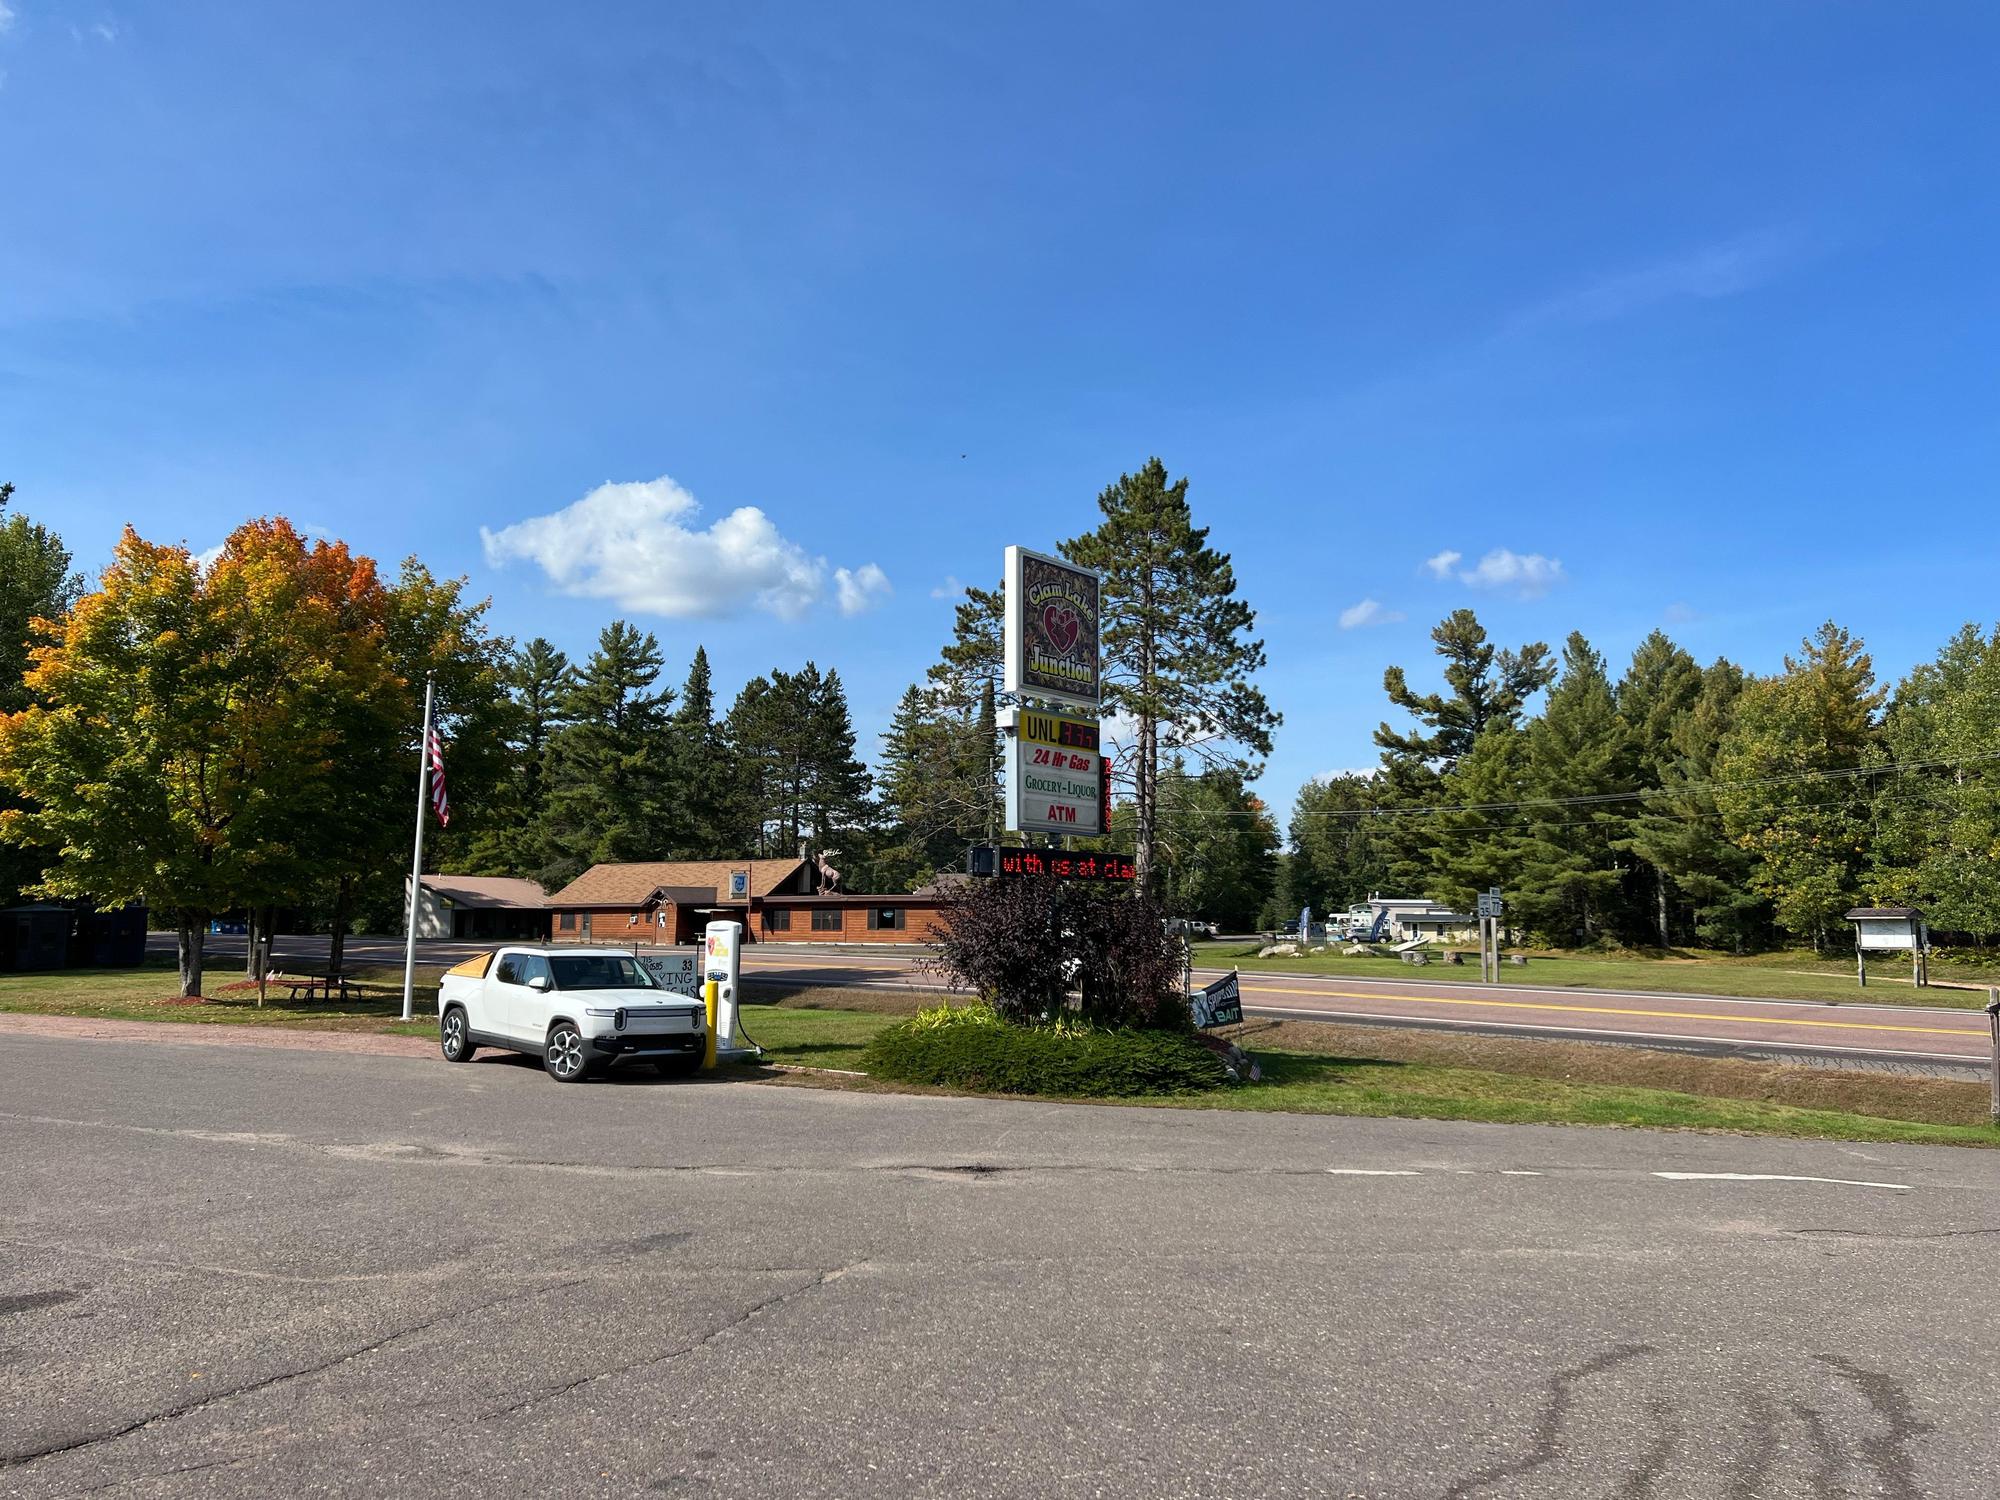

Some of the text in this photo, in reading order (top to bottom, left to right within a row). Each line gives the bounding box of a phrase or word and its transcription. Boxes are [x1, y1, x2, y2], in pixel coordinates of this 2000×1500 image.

[1028, 580, 1094, 623] Clam Lake
[1030, 644, 1093, 684] Junction
[1033, 748, 1090, 772] 24 Hr Gas
[1025, 775, 1096, 800] GROCERY-LIQUOR
[1047, 804, 1077, 823] ATM
[1002, 852, 1044, 875] with
[1051, 859, 1070, 876] us
[1078, 857, 1097, 877] at
[1479, 907, 1490, 917] 35
[682, 959, 693, 971] 33
[1215, 1007, 1239, 1023] BAIT
